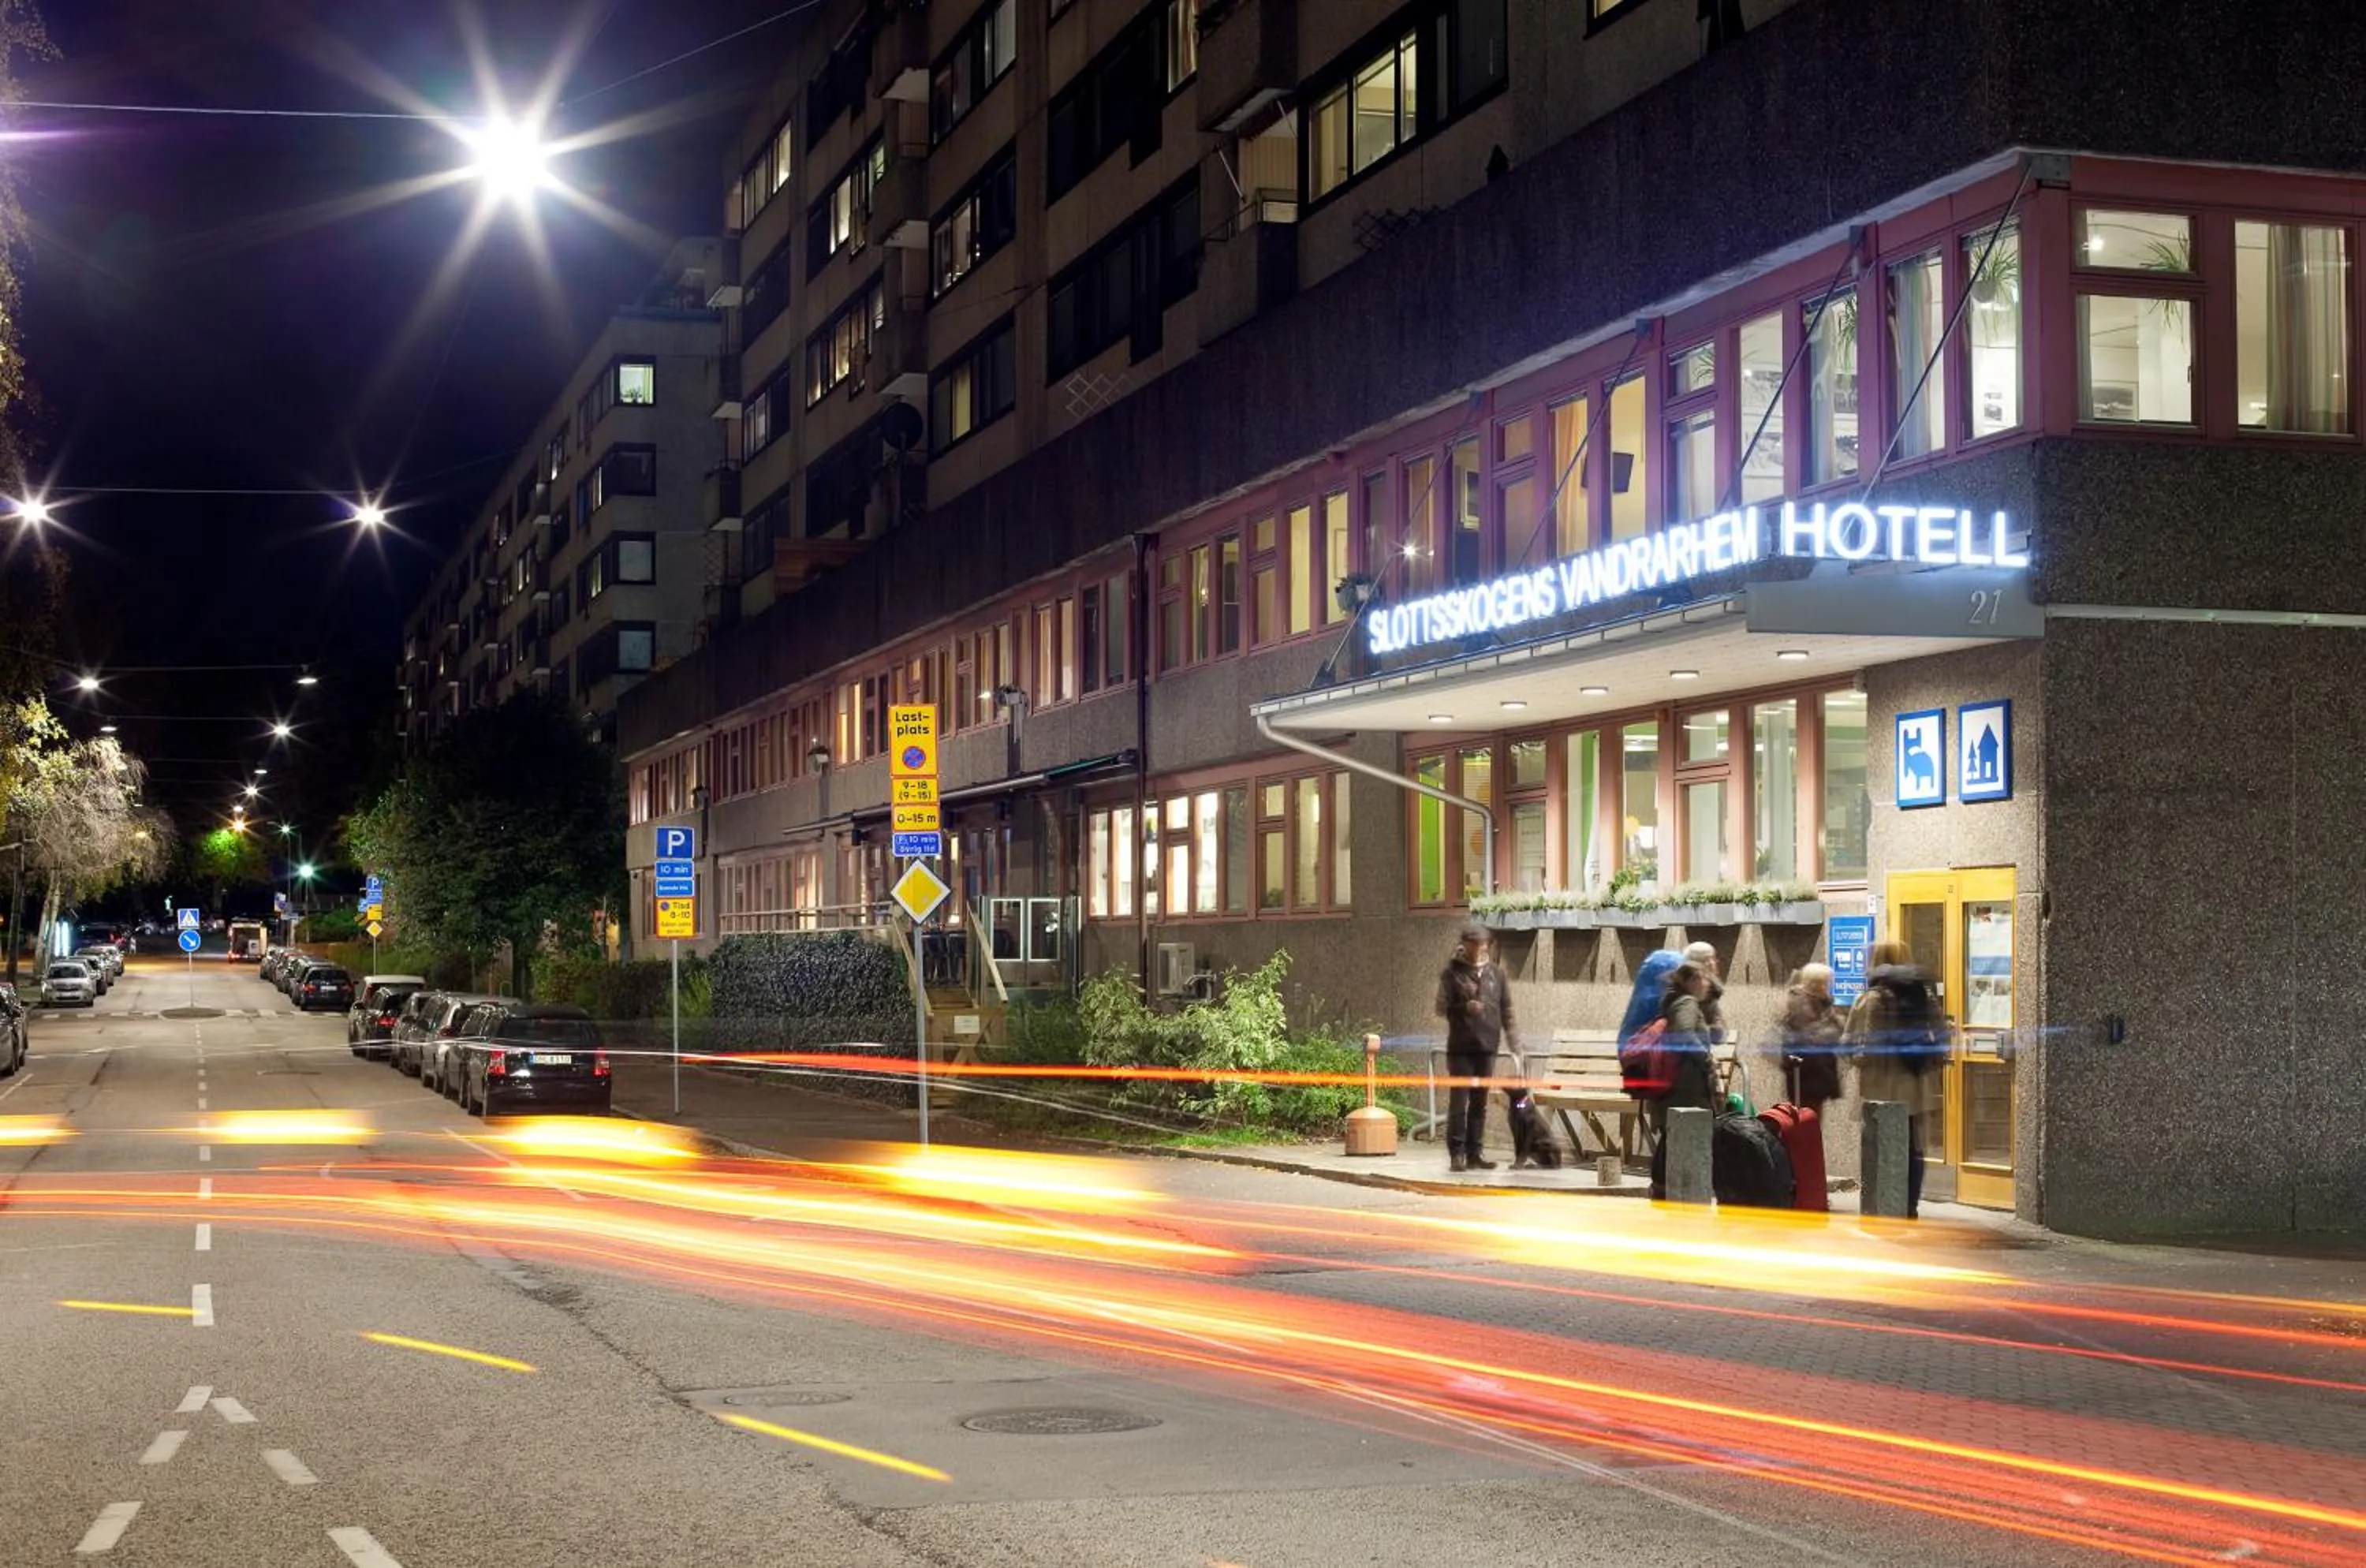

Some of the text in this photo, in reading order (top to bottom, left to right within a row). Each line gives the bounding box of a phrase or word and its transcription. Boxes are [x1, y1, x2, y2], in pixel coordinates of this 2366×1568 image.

[1783, 501, 2028, 567] HOTELL
[1368, 506, 1757, 654] SLOTTSSKOGENS VANDRARHEM
[895, 711, 930, 722] Last-
[897, 724, 930, 738] plats
[667, 830, 685, 856] P
